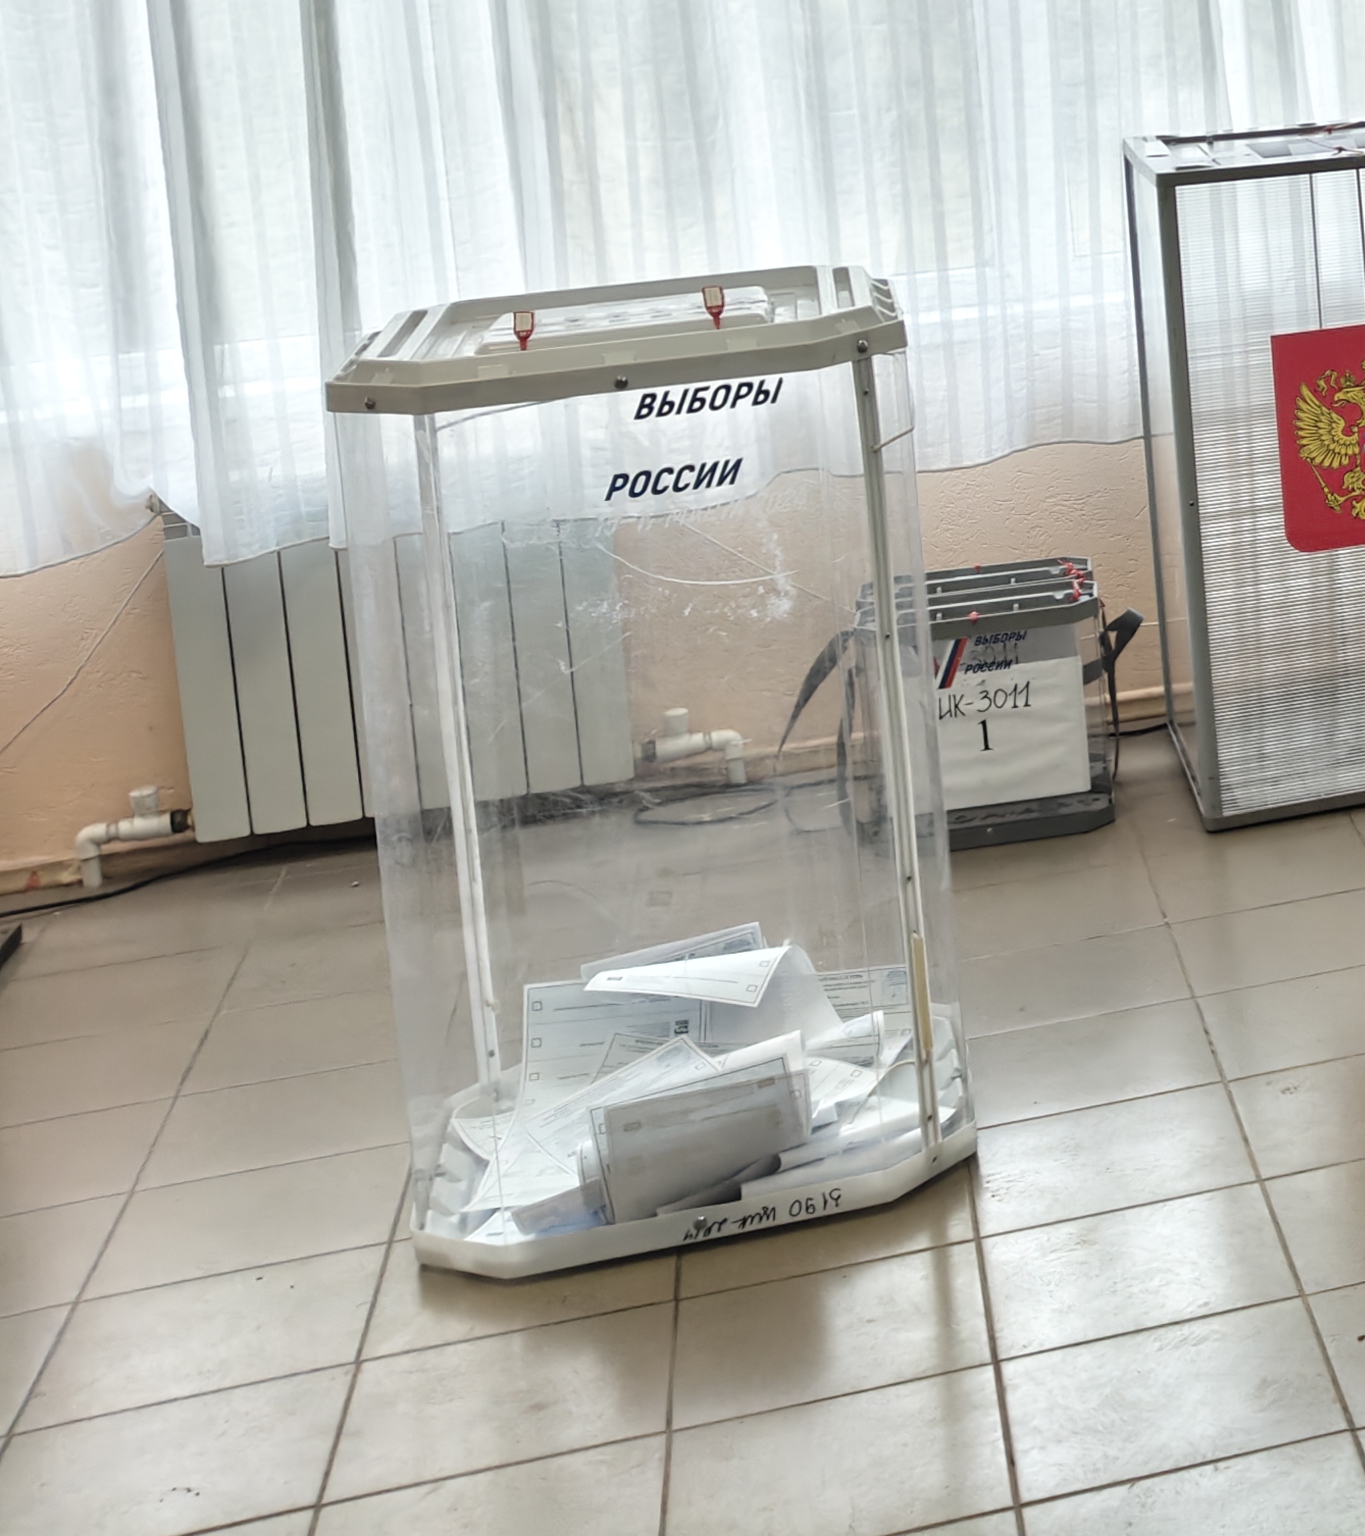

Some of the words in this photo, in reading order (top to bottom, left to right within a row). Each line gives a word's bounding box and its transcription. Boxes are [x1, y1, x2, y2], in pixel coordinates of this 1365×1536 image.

[634, 378, 783, 420] ВЫБОРЫ
[604, 458, 743, 501] РОССИИ
[974, 630, 1027, 647] ВЫБОРЫ
[964, 658, 1014, 675] РОССИИ
[977, 719, 994, 751] 1
